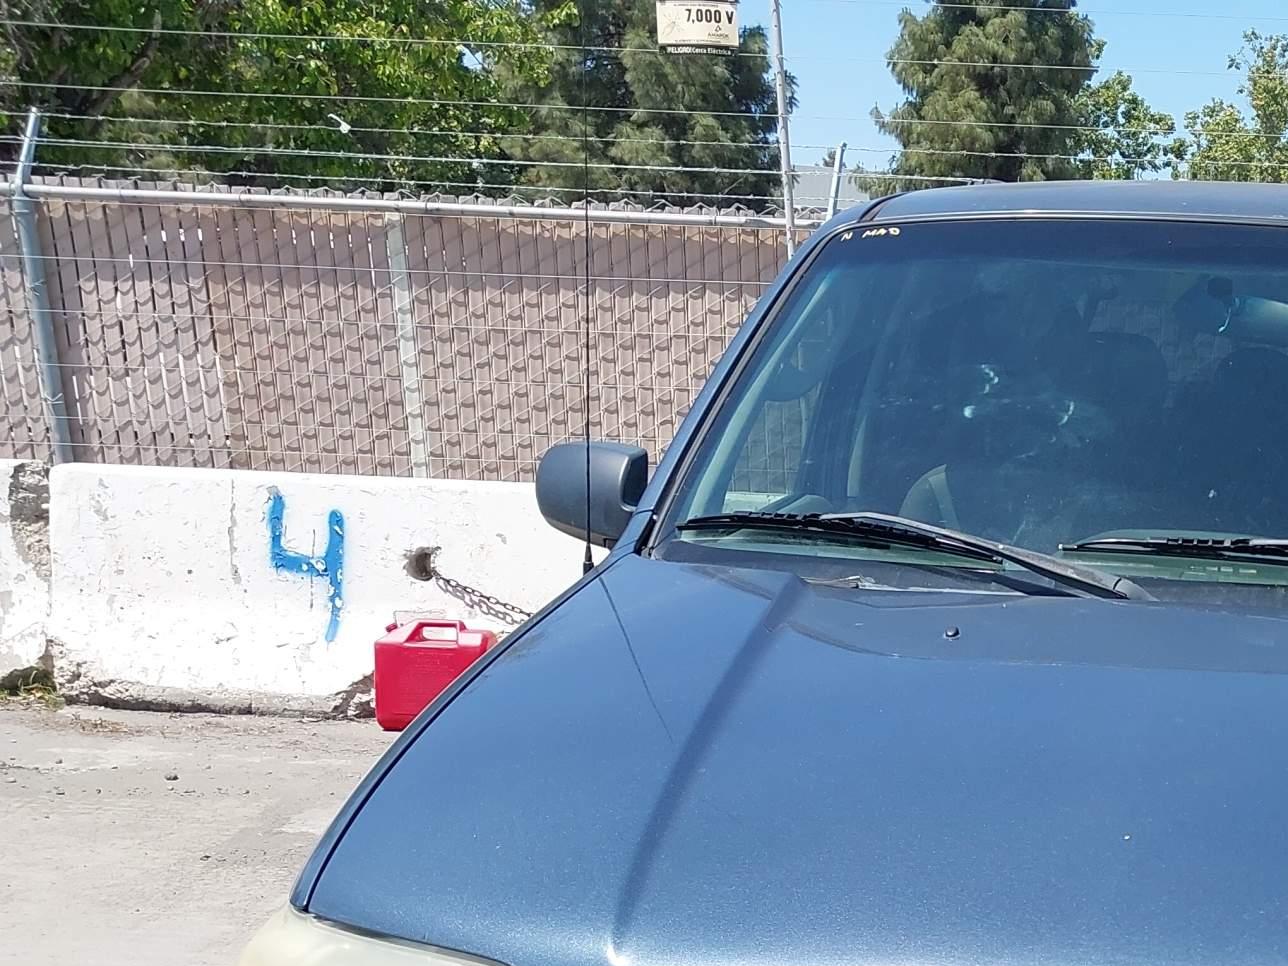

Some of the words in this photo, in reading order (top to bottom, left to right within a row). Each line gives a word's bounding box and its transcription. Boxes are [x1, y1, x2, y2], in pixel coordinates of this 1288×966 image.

[685, 9, 722, 24] 7,000
[725, 11, 735, 25] V
[841, 232, 853, 242] N
[267, 491, 344, 645] 4
